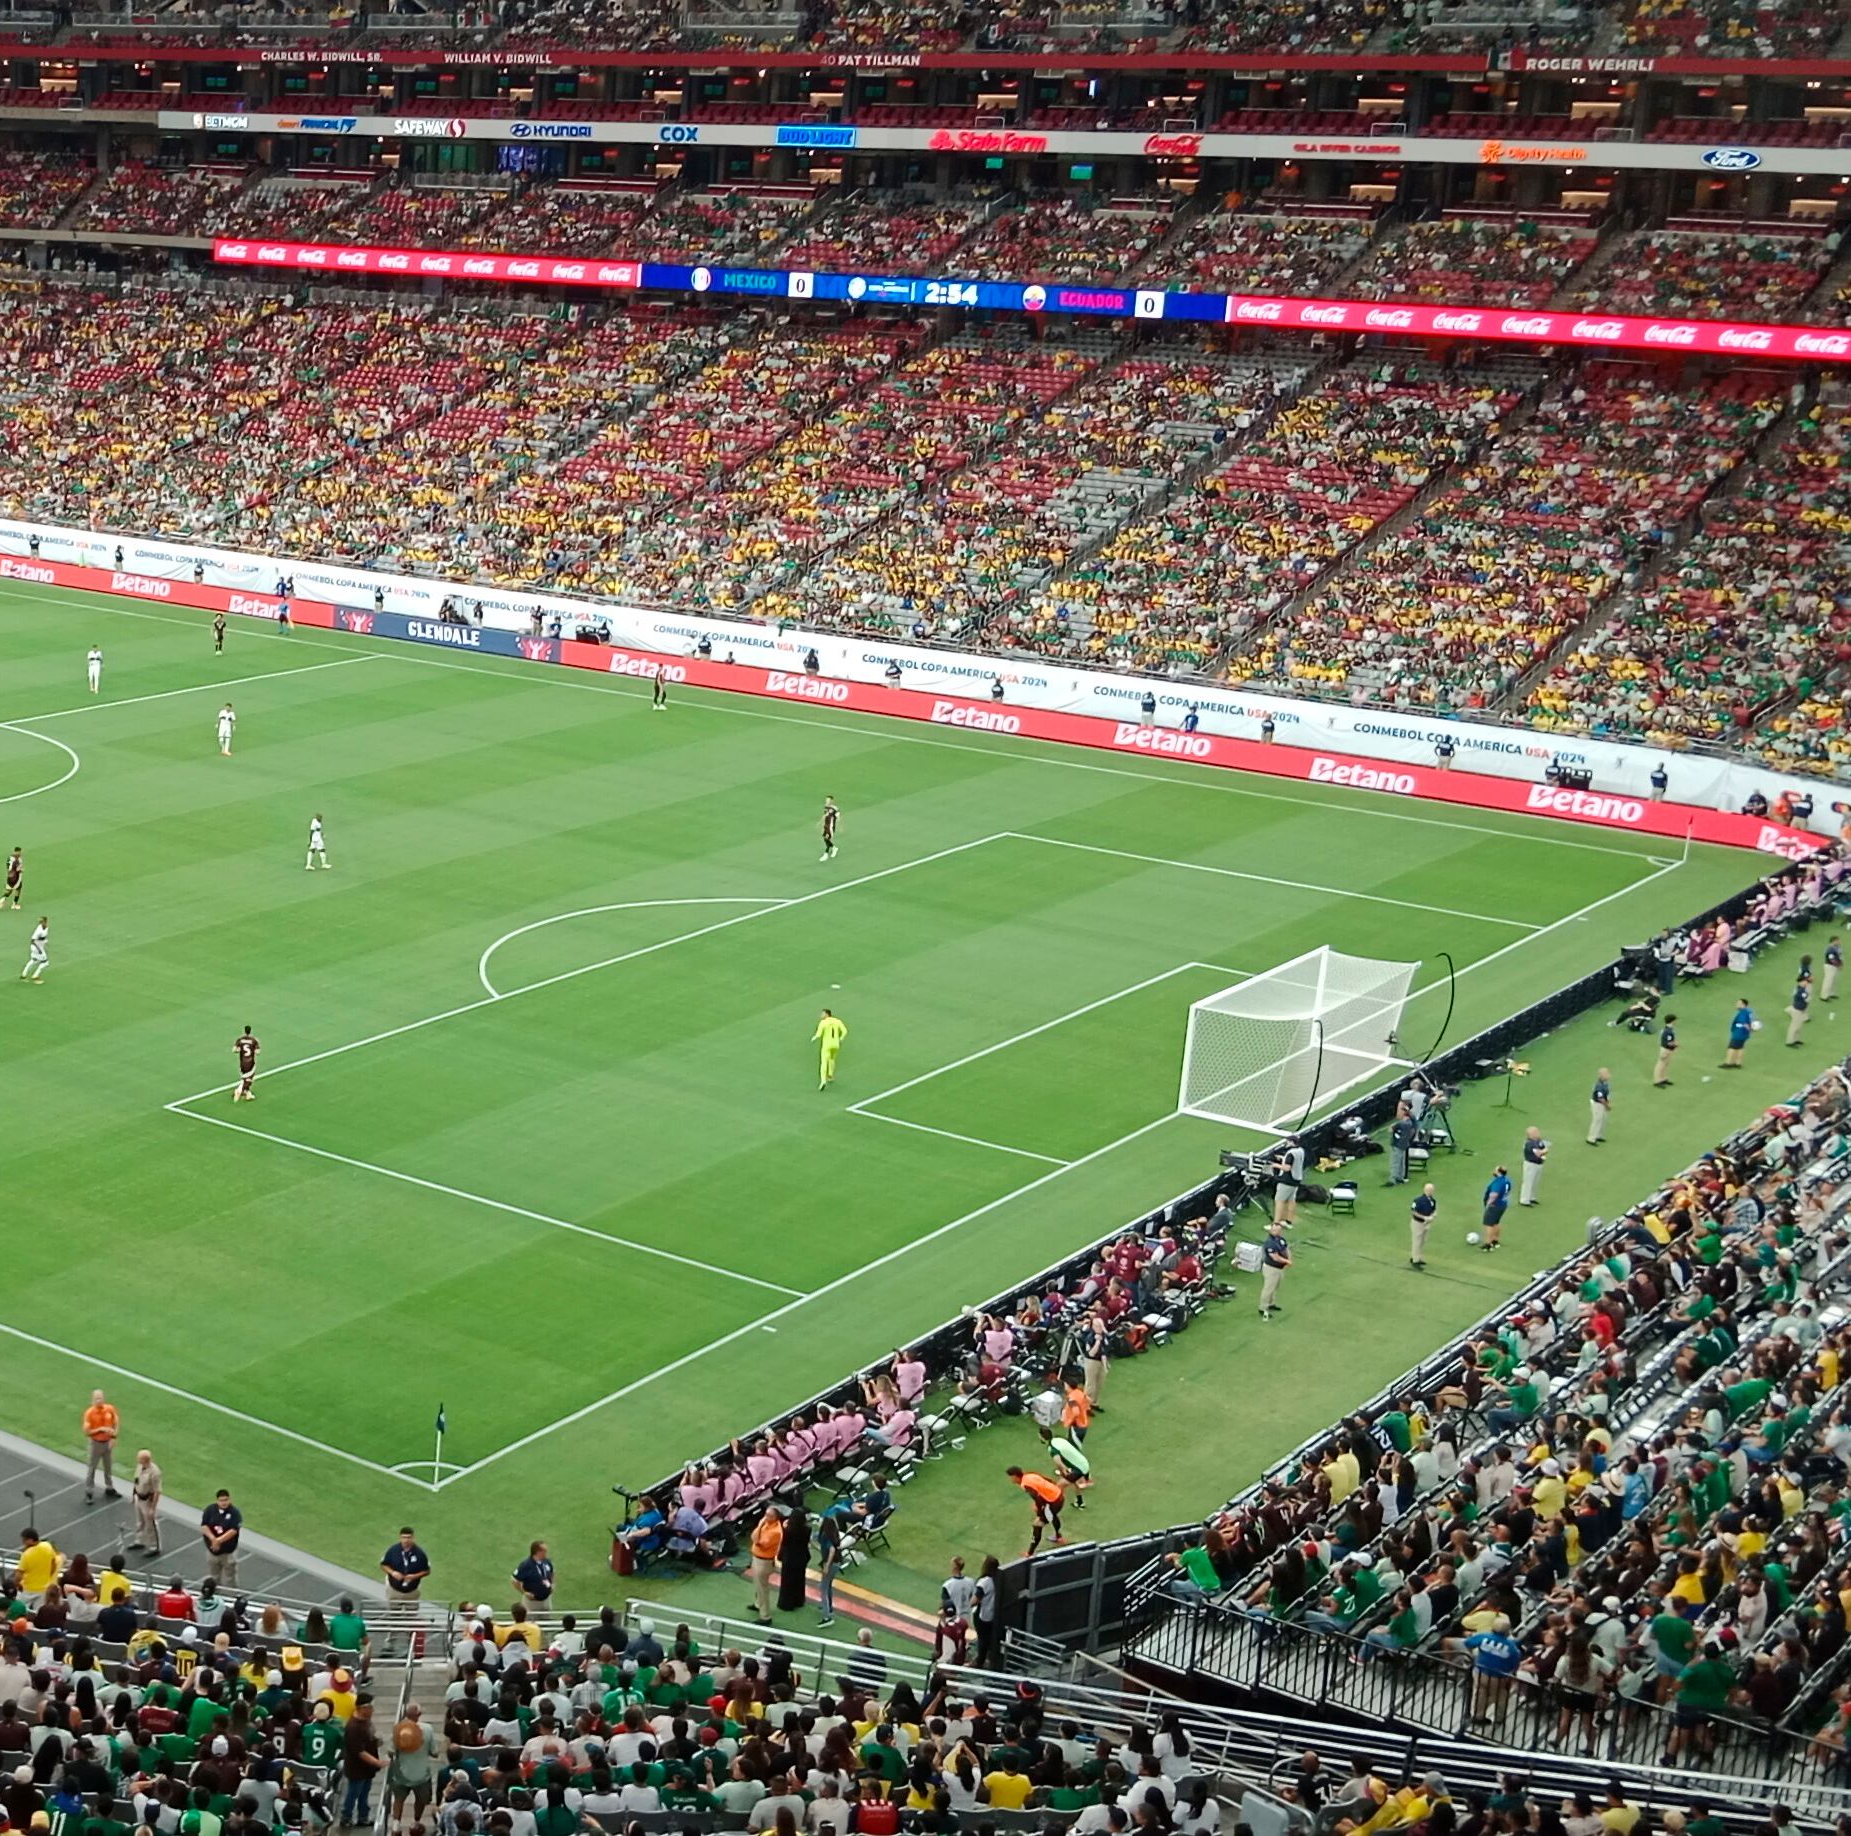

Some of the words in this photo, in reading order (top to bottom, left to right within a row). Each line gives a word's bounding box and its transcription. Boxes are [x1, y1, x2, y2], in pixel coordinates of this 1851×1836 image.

[261, 51, 305, 61] CHARLES
[307, 52, 319, 61] W.
[444, 53, 491, 63] WILLIAM
[493, 54, 504, 63] V.
[506, 54, 553, 64] BIDWILL
[837, 55, 862, 66] PAT
[864, 55, 921, 66] TILLMAN
[1525, 58, 1583, 71] ROGER
[1588, 58, 1655, 71] WEHRLI
[394, 119, 449, 135] SAFEWAY
[533, 125, 592, 137] HYUNDAI
[659, 126, 699, 142] COX
[958, 131, 1001, 151] State
[1003, 132, 1047, 152] Farm
[1710, 150, 1750, 166] Ford
[723, 273, 777, 290] MEXICO
[795, 279, 806, 293] 0
[925, 282, 978, 305] 2:54
[1059, 291, 1125, 309] ECUADOR
[1144, 297, 1155, 313] 0
[111, 572, 171, 597] Betano
[290, 572, 334, 585] CONMEBOL
[336, 578, 356, 588] COPA
[411, 589, 430, 599] 2024
[228, 595, 283, 620] Betan
[407, 619, 480, 647] GLENDALE
[706, 631, 731, 643] COPA
[732, 636, 775, 649] AMERICA
[777, 642, 794, 652] USA
[921, 662, 948, 674] COPA
[950, 666, 996, 680] AMERICA
[1021, 676, 1047, 687] 2024
[765, 671, 849, 702] Betano
[929, 699, 1021, 736] Betano
[1159, 695, 1190, 709] COPA
[1192, 701, 1245, 716] AMERICA
[1272, 711, 1300, 724] 2024
[1114, 722, 1212, 758] Betano
[1353, 722, 1424, 741] CONMEBOL
[1426, 732, 1461, 747] COA
[1463, 739, 1522, 755] AMERICA
[1525, 746, 1549, 759] USA
[1308, 757, 1416, 795] Betano
[1526, 782, 1644, 825] Betano
[274, 1736, 286, 1754] 9
[312, 1736, 326, 1758] 9
